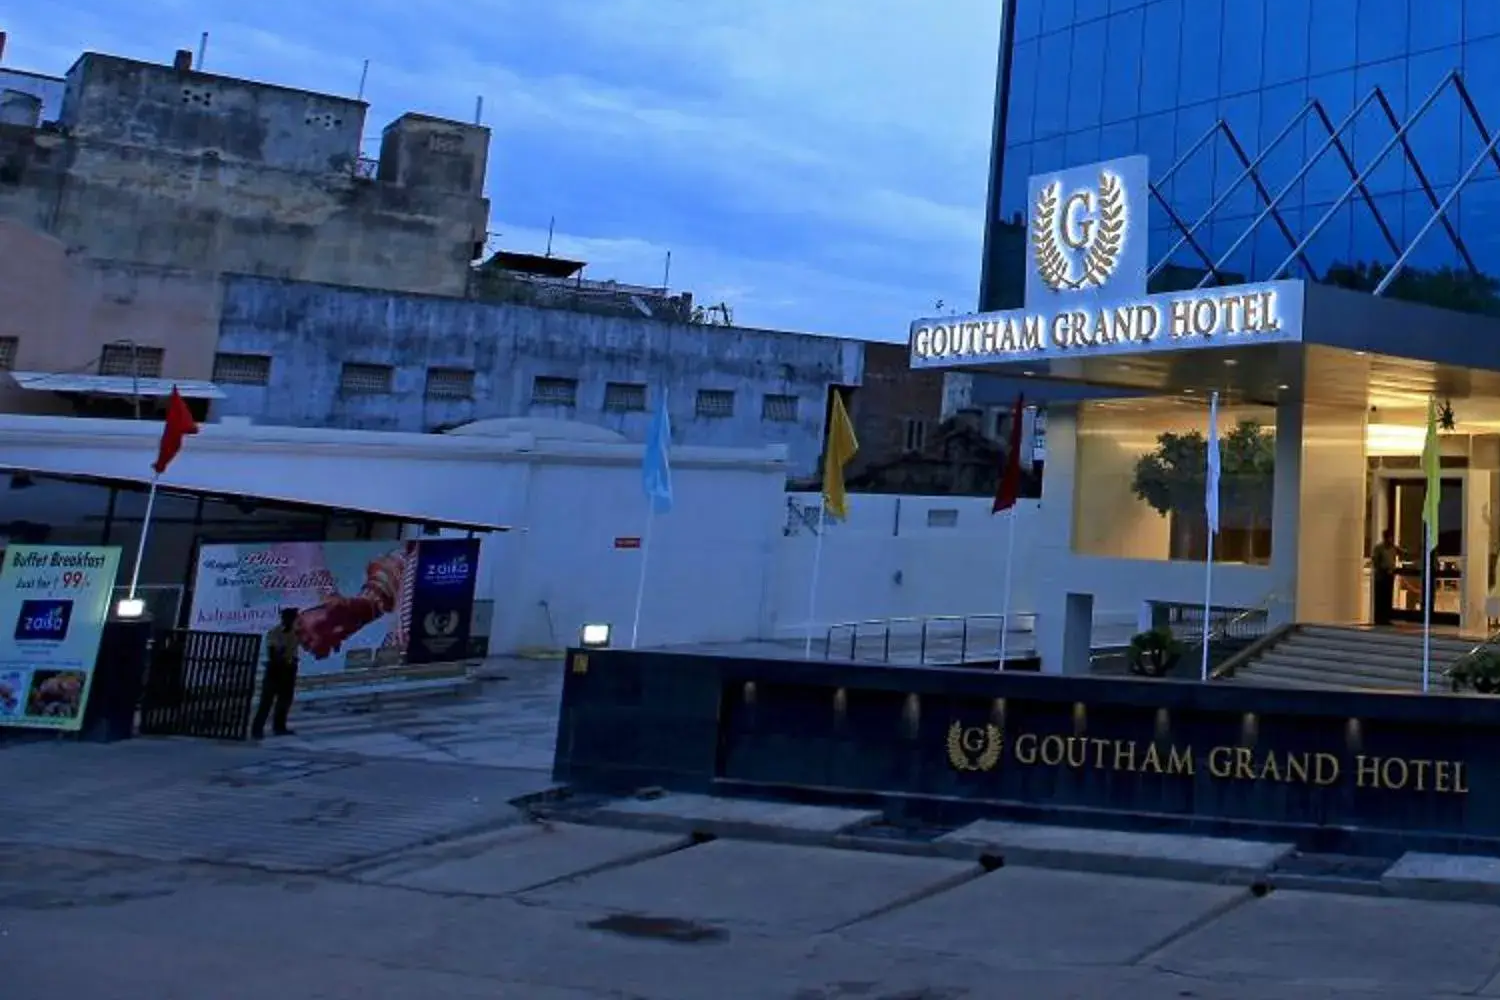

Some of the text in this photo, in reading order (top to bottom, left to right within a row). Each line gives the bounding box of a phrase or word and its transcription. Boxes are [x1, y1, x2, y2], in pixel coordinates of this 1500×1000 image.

[1060, 190, 1096, 250] G
[913, 291, 1279, 359] GOUTHAM GRAND HOTEL
[12, 551, 106, 569] Buffet Breakfast
[1014, 734, 1196, 776] GOUTHAM
[1207, 746, 1341, 787] GRAND
[1355, 754, 1471, 794] HOTEL
